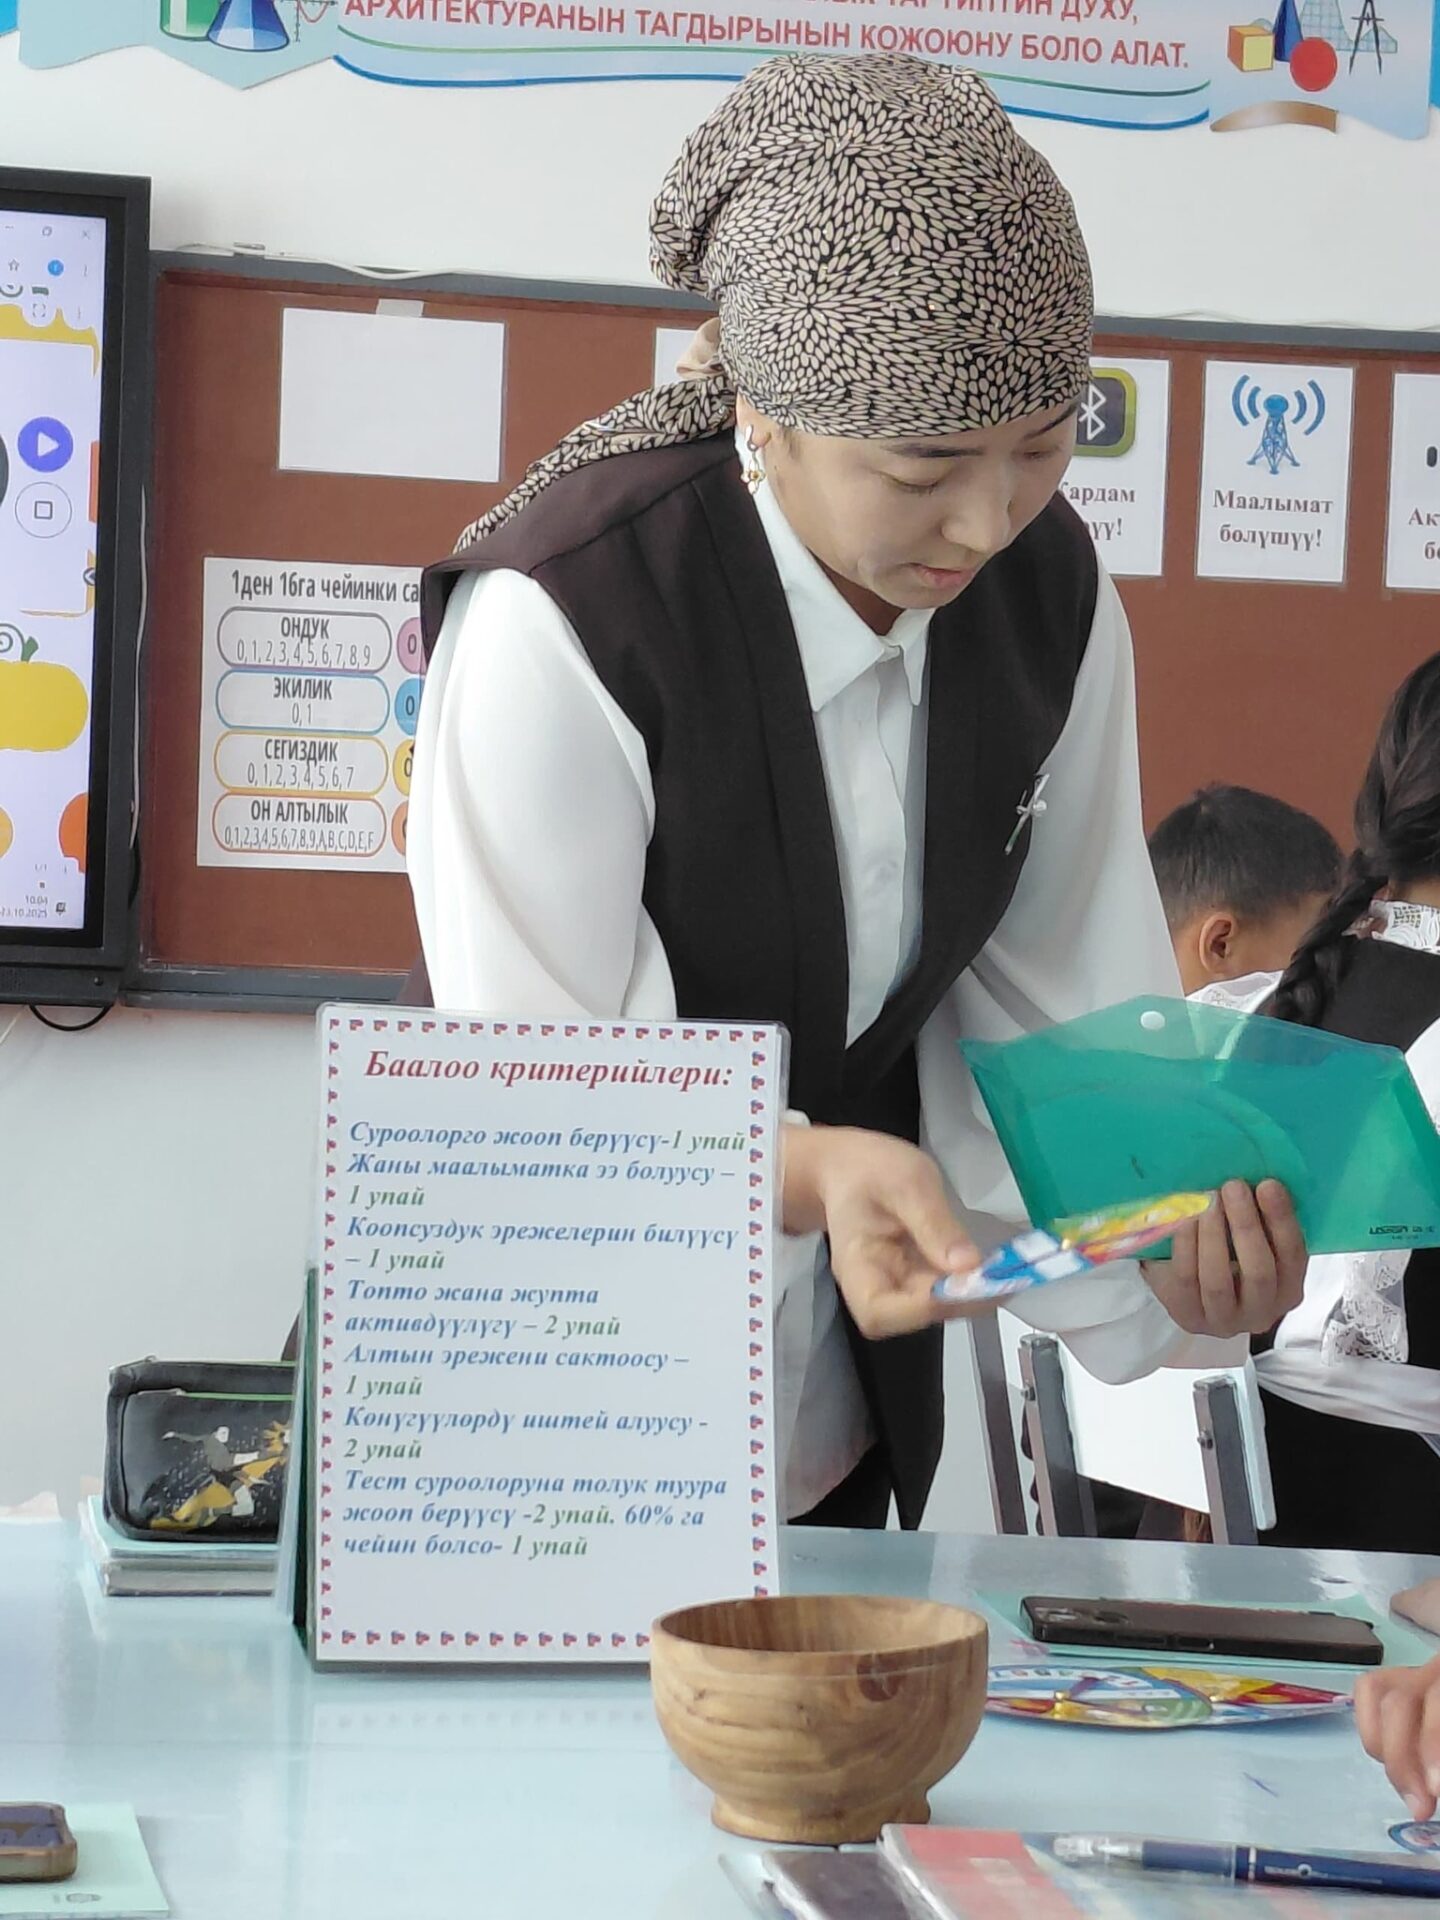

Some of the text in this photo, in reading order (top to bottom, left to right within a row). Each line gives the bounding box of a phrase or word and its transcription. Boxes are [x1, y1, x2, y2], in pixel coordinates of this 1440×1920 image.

[345, 0, 1188, 68] АРХИТЕКТУРАНЫН ТАГДЫРЫНЫН КОЖОЮНУ БОЛО АЛАТ.
[1060, 481, 1136, 507] ардам
[1213, 489, 1333, 514] Маалымат
[232, 569, 273, 600] 1ден
[279, 571, 315, 598] 16га
[321, 573, 397, 602] чейинки
[281, 616, 330, 643] ОНДУК
[273, 677, 333, 700] ЭКИЛИК
[264, 738, 339, 766] СЕГИЗДИК
[251, 800, 349, 824] ОН АЛТЫЛЫК
[364, 1051, 732, 1092] Баалоо критерийлери:
[350, 1122, 486, 1149] Суроолорго
[493, 1131, 562, 1146] жооп
[688, 1132, 745, 1154] упай
[427, 1161, 589, 1178] маалыматка
[597, 1165, 618, 1178] ээ
[626, 1160, 714, 1186] болуусу
[350, 1185, 424, 1210] 1 упай
[347, 1216, 739, 1250] Коопсуздук эрежелерин билүүсү
[369, 1248, 380, 1268] 1
[385, 1251, 444, 1274] упай
[348, 1280, 598, 1308] Топто жана жупта
[345, 1313, 516, 1339] активдүүлүгү
[544, 1315, 557, 1334] 2
[562, 1317, 620, 1340] упай
[344, 1344, 433, 1364] Алтын
[443, 1351, 548, 1370] эрежени
[556, 1352, 668, 1373] сактоосу
[346, 1375, 422, 1400] 1 упай
[523, 1410, 608, 1430] иштей
[616, 1416, 692, 1436] алуусу
[344, 1438, 421, 1464] 2 упай
[346, 1470, 727, 1500] Тест суроолоруна толук туура
[343, 1508, 413, 1522] жооп
[422, 1503, 516, 1529] берүүсү
[551, 1505, 614, 1529] упай.
[625, 1505, 673, 1525] 60%
[681, 1512, 704, 1525] га
[344, 1534, 587, 1560] чейин болсо- 1 упай
